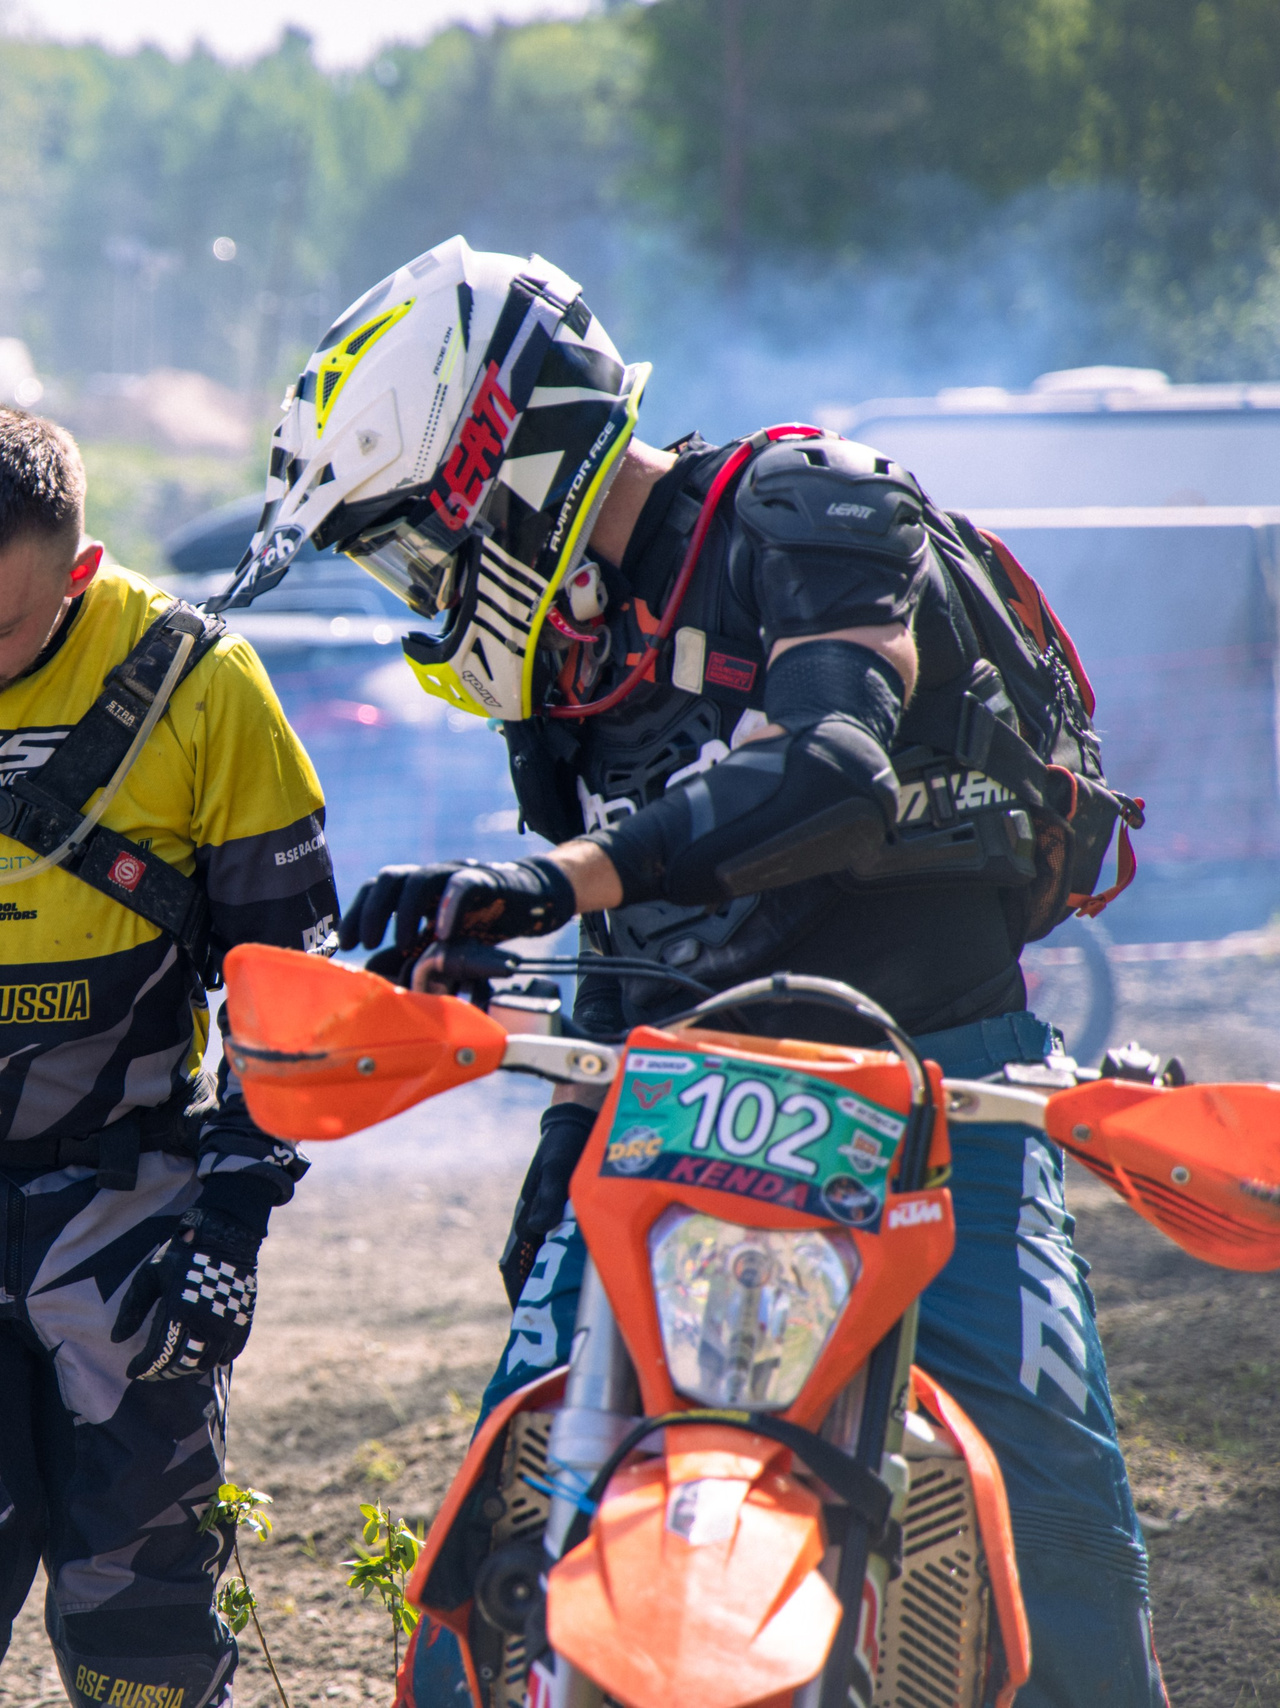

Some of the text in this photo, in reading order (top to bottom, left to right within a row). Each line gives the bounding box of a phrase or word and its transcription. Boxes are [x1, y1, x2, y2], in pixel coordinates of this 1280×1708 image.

[429, 359, 518, 532] LEATT
[549, 421, 615, 553] AVIATOR ACE
[607, 1136, 665, 1163] DRC
[677, 1070, 832, 1177] 102
[669, 1154, 809, 1208] KENDA
[887, 1199, 943, 1230] KTM
[75, 1664, 185, 1708] BSE RUSSIA
